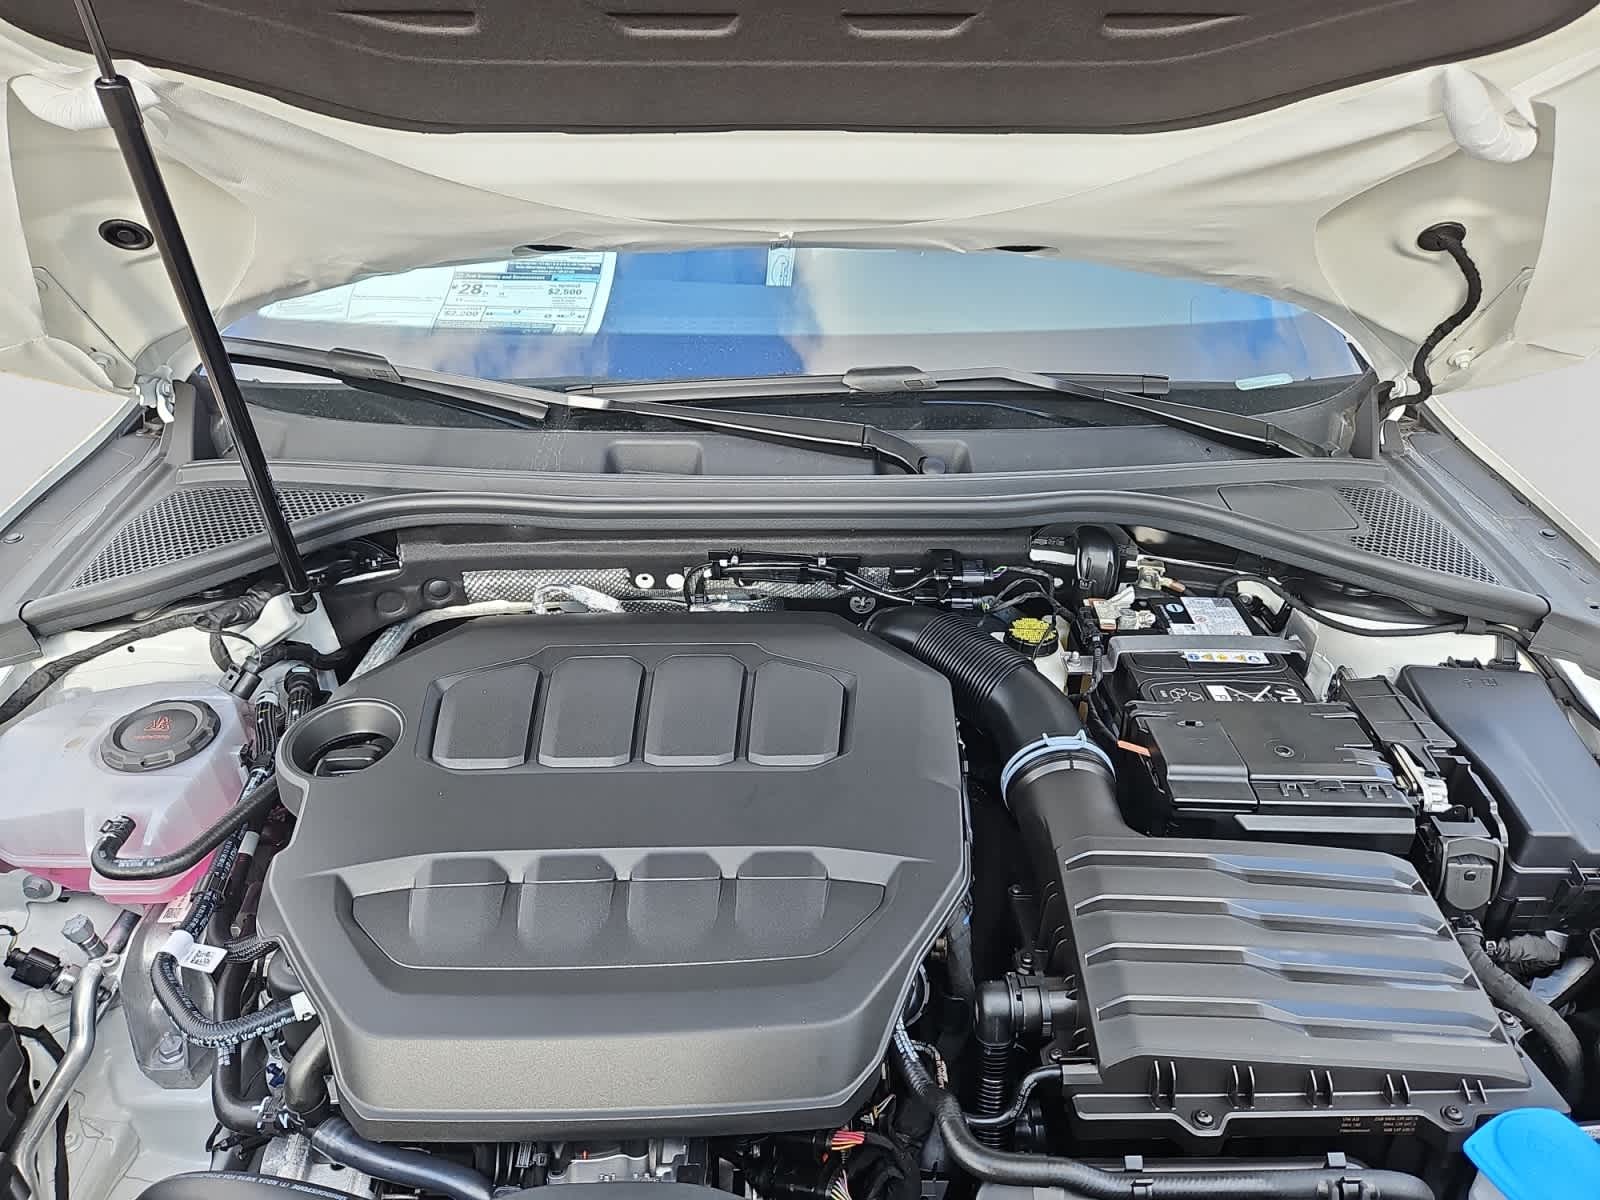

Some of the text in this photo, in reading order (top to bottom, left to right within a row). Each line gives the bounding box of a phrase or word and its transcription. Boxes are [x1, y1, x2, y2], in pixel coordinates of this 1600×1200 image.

[458, 283, 483, 295] 28
[548, 287, 582, 296] $2,500
[1274, 688, 1302, 703] 70
